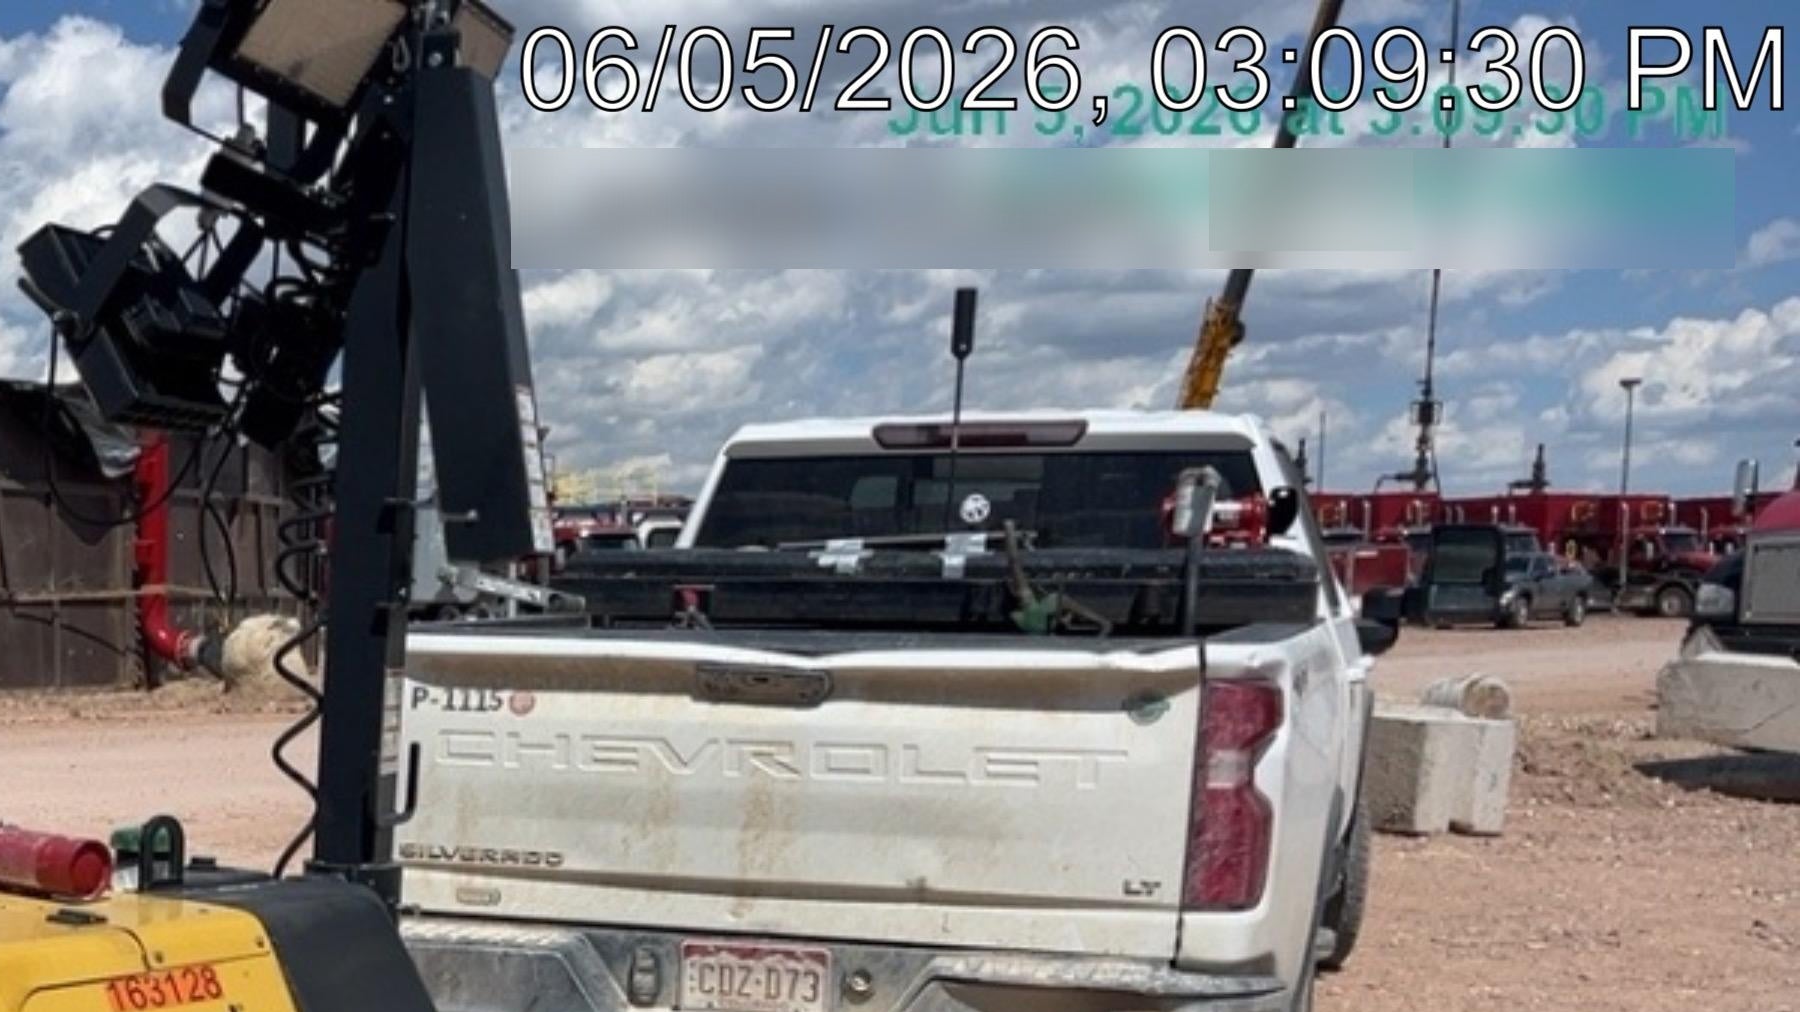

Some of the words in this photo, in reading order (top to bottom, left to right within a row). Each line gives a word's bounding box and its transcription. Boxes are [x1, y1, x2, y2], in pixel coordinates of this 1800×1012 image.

[435, 727, 1130, 790] CHEVROLET
[399, 842, 565, 868] SILVERADO
[1122, 879, 1161, 897] LT
[107, 963, 224, 1012] 163128
